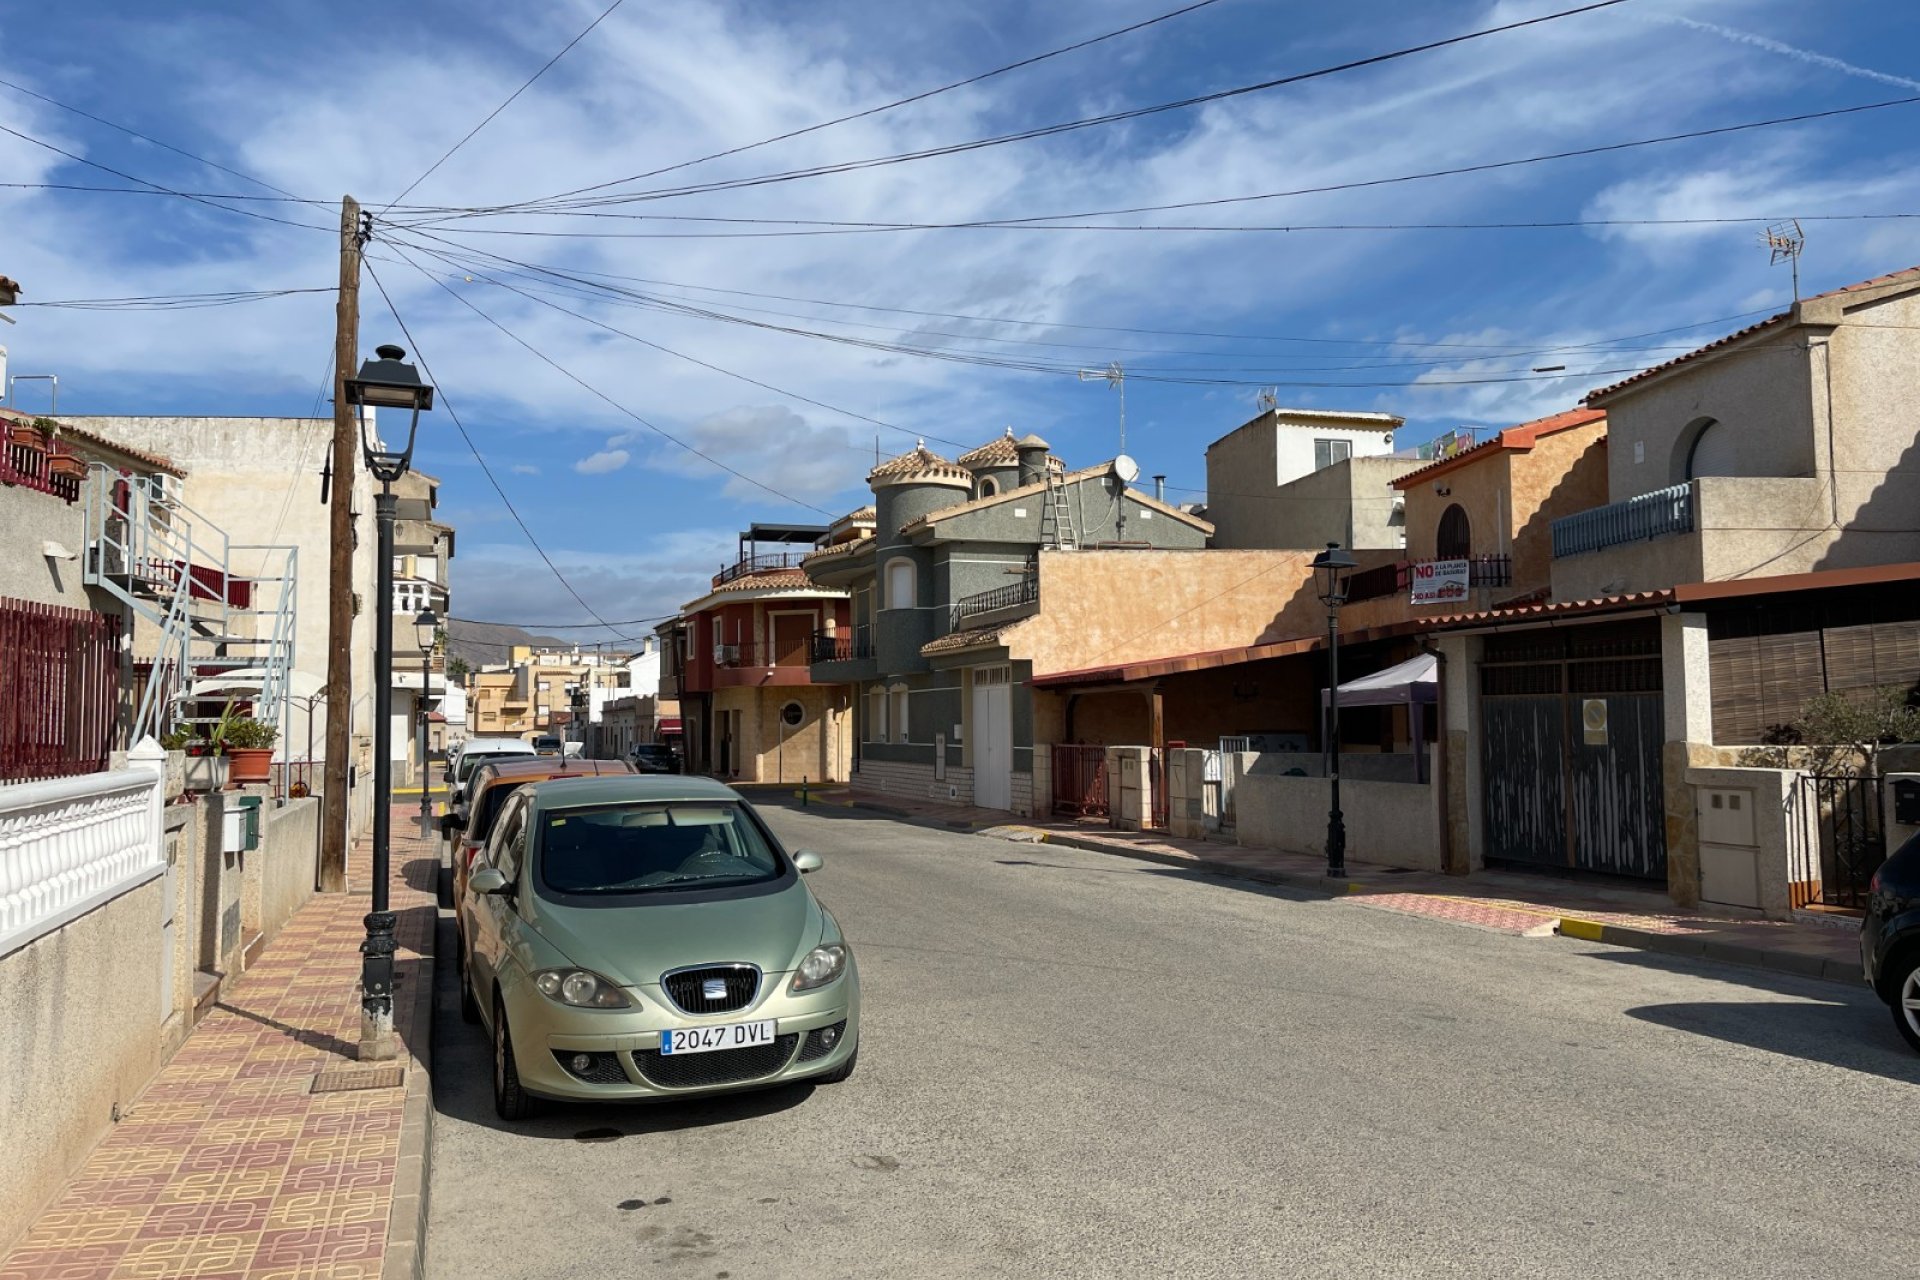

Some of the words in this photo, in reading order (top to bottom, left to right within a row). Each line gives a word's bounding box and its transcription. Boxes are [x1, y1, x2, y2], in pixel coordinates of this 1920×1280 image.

[1416, 565, 1434, 578] NO
[674, 1027, 726, 1050] 2047
[735, 1023, 770, 1044] DVL
